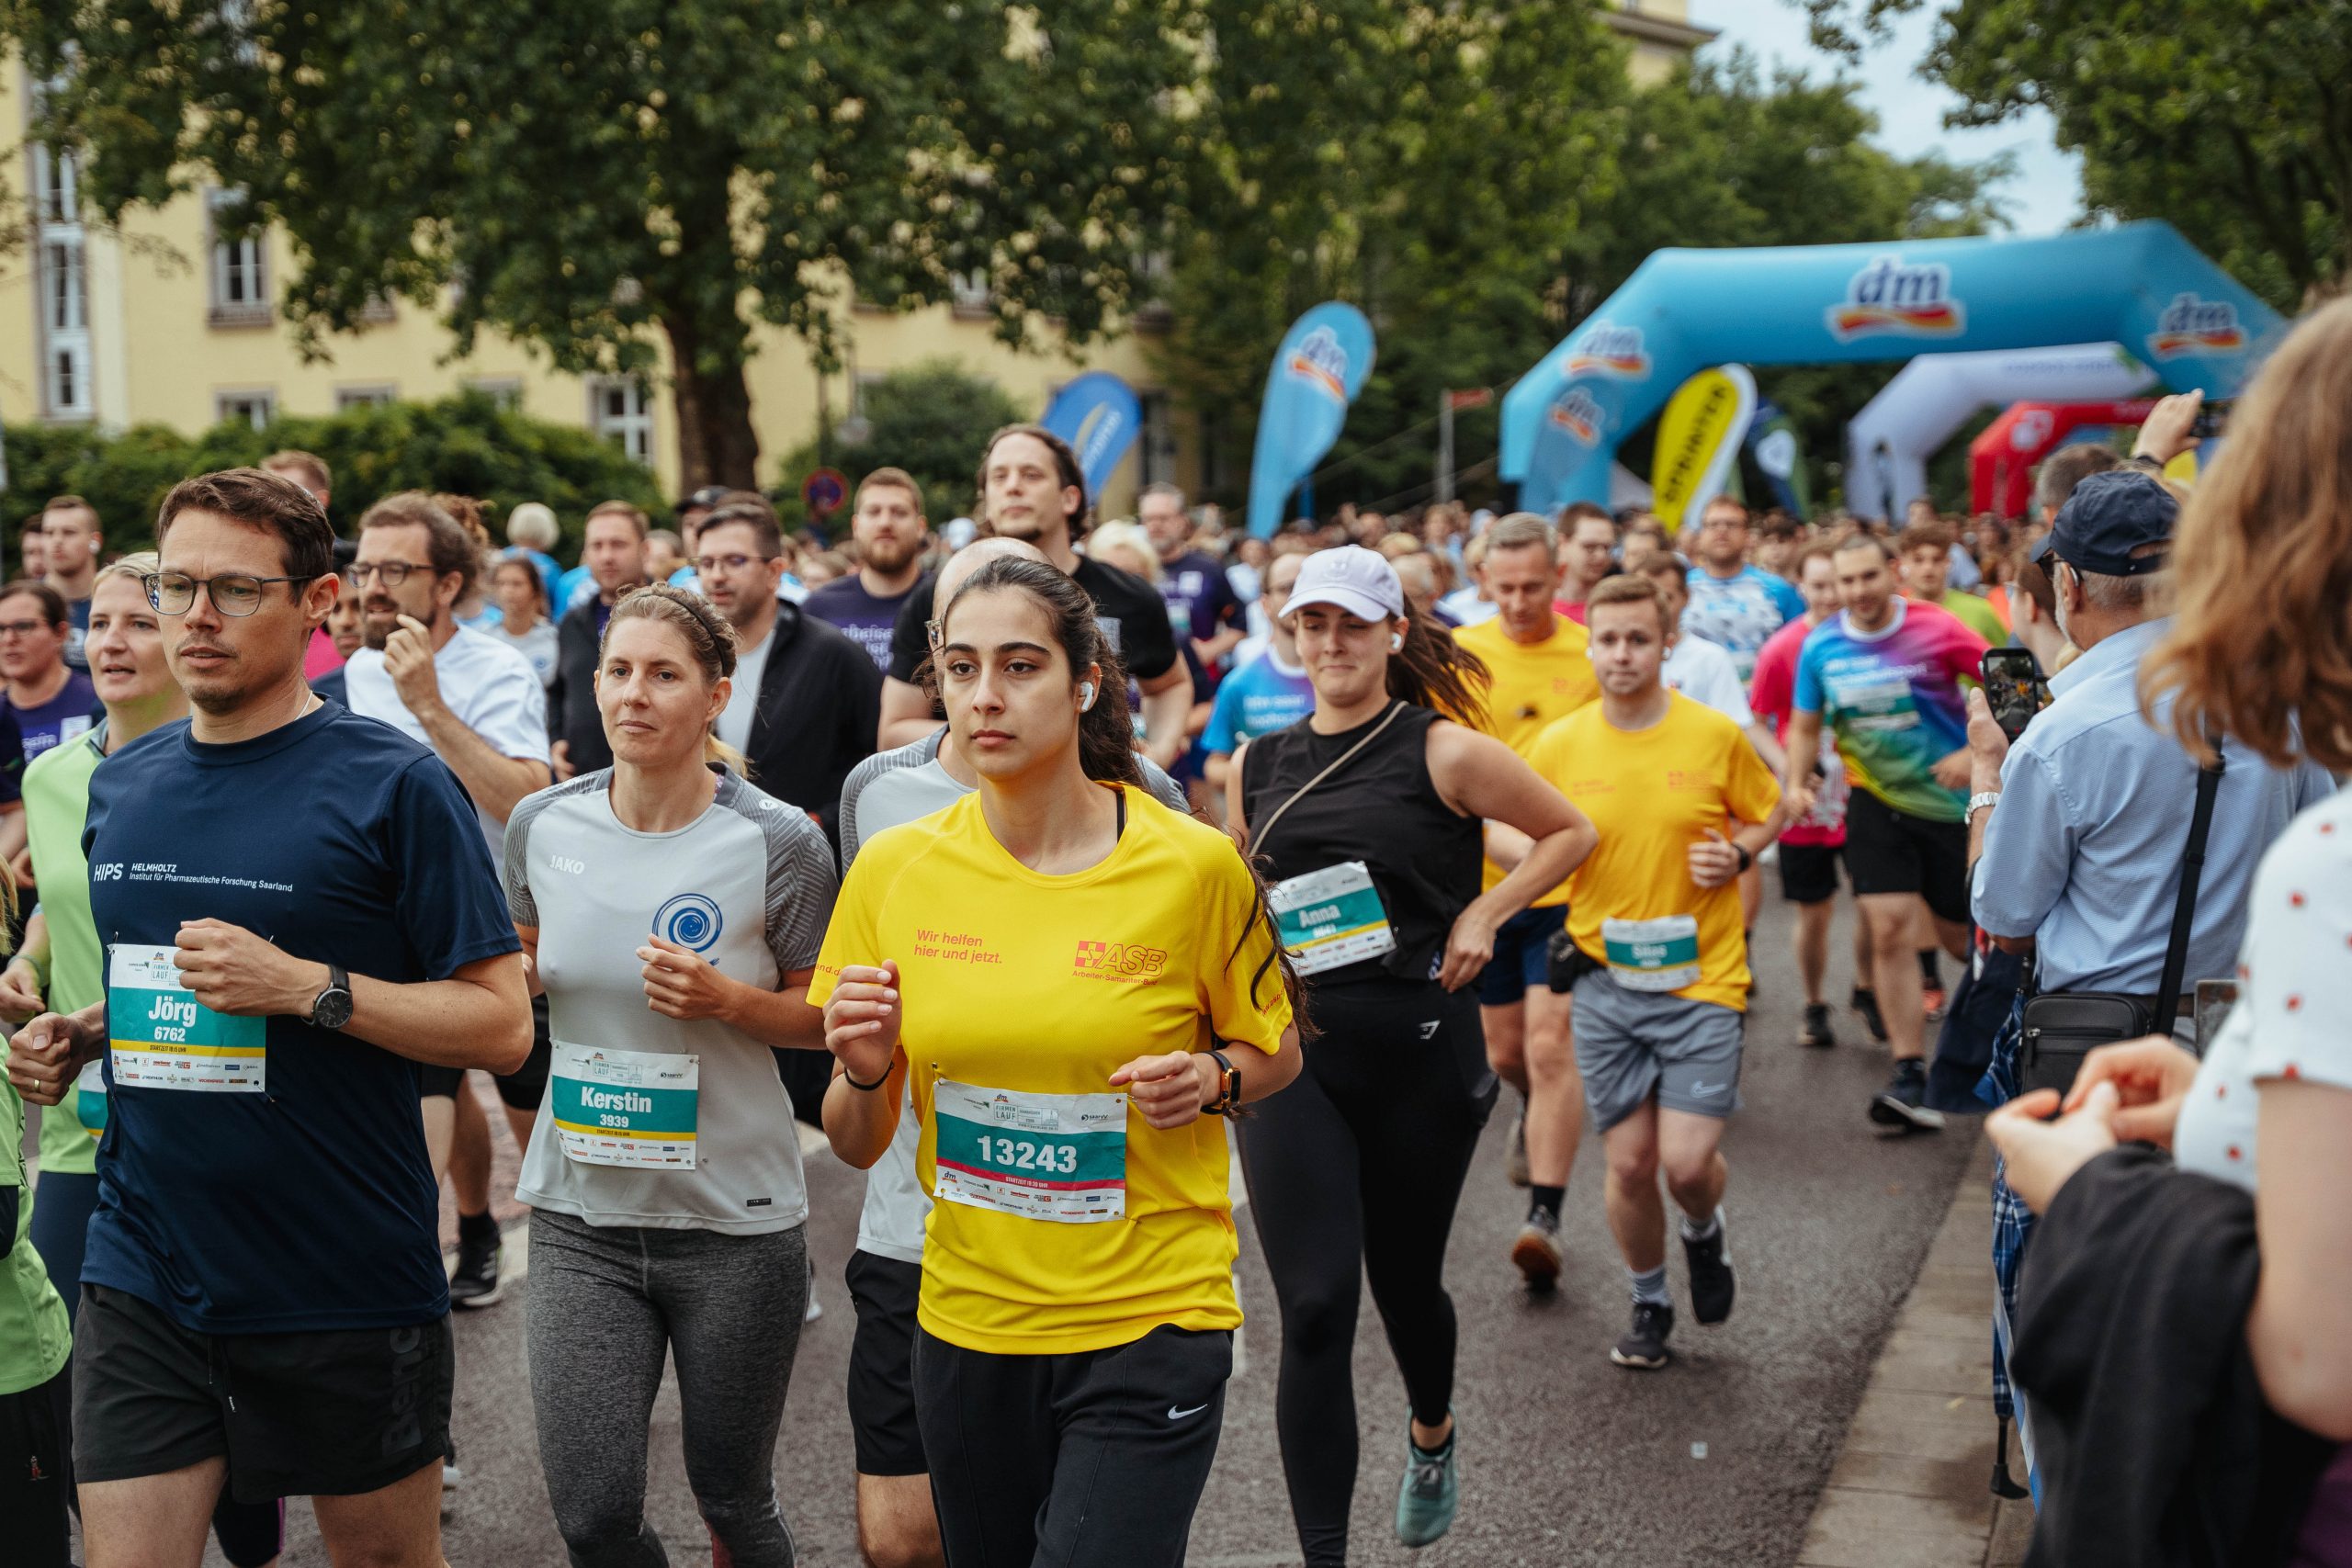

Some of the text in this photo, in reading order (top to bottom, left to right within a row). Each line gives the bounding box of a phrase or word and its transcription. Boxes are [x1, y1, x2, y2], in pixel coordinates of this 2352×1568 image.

[1858, 261, 1940, 303] dm
[2165, 296, 2231, 332] dm
[94, 863, 123, 882] HIPS
[131, 863, 177, 873] HELMHOLTZ
[549, 854, 585, 874] JAKO
[130, 872, 293, 892] Institut für Pharmazeutische Forschung Saarland
[1298, 904, 1341, 929] Anna
[917, 929, 983, 948] Wir helfen
[914, 944, 1002, 964] hier und jetzt.
[1094, 942, 1168, 977] ASB
[153, 971, 169, 980] LAUF
[148, 995, 198, 1028] Jörg
[153, 1026, 186, 1042] 6762
[594, 1067, 610, 1076] LAUF
[581, 1086, 652, 1113] Kerstin
[599, 1113, 629, 1128] 3939
[995, 1111, 1016, 1121] LAUF
[977, 1134, 1078, 1174] 13243
[944, 1171, 956, 1180] dm
[1005, 1176, 1027, 1186] STARTZEIT
